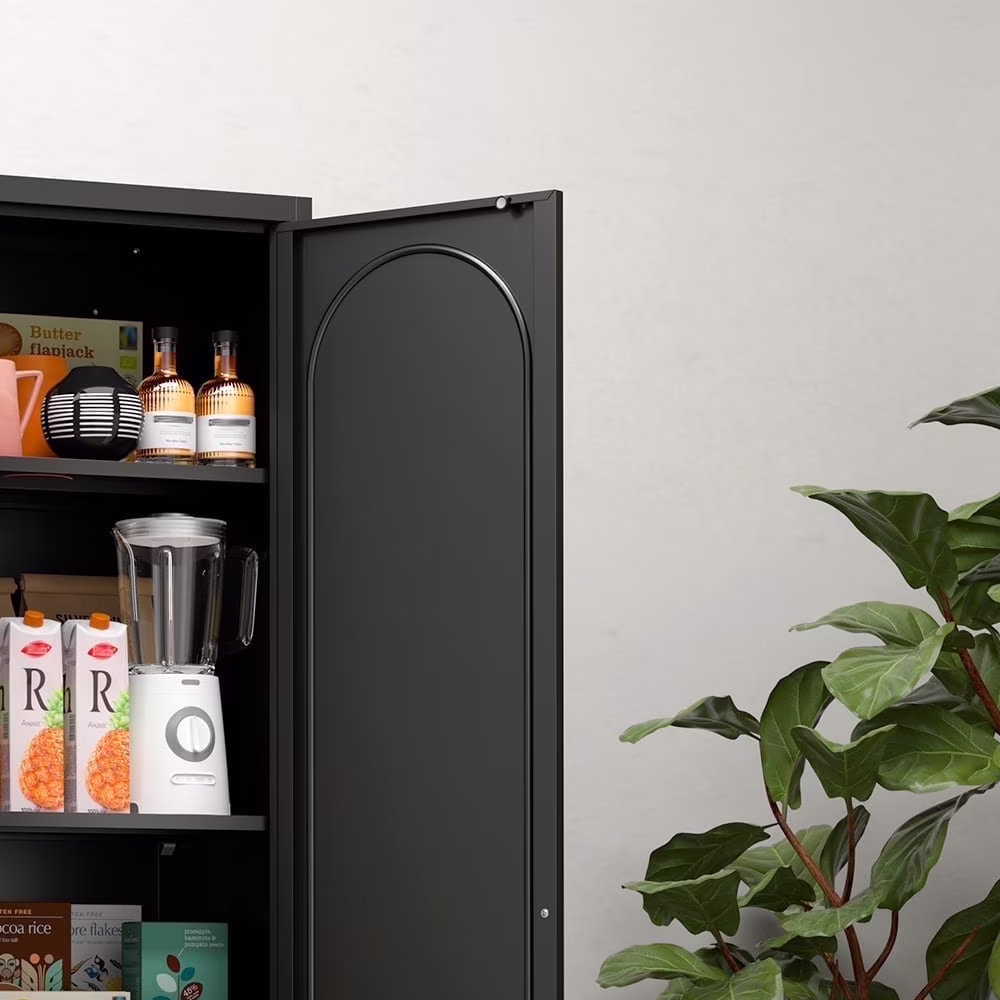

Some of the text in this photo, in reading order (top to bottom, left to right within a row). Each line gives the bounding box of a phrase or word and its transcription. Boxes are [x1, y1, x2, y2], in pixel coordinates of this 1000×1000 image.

[30, 325, 81, 341] Butter
[30, 343, 95, 358] flapjack
[23, 667, 49, 711] R
[89, 669, 115, 713] R
[28, 921, 52, 935] rice
[90, 922, 122, 937] flakes
